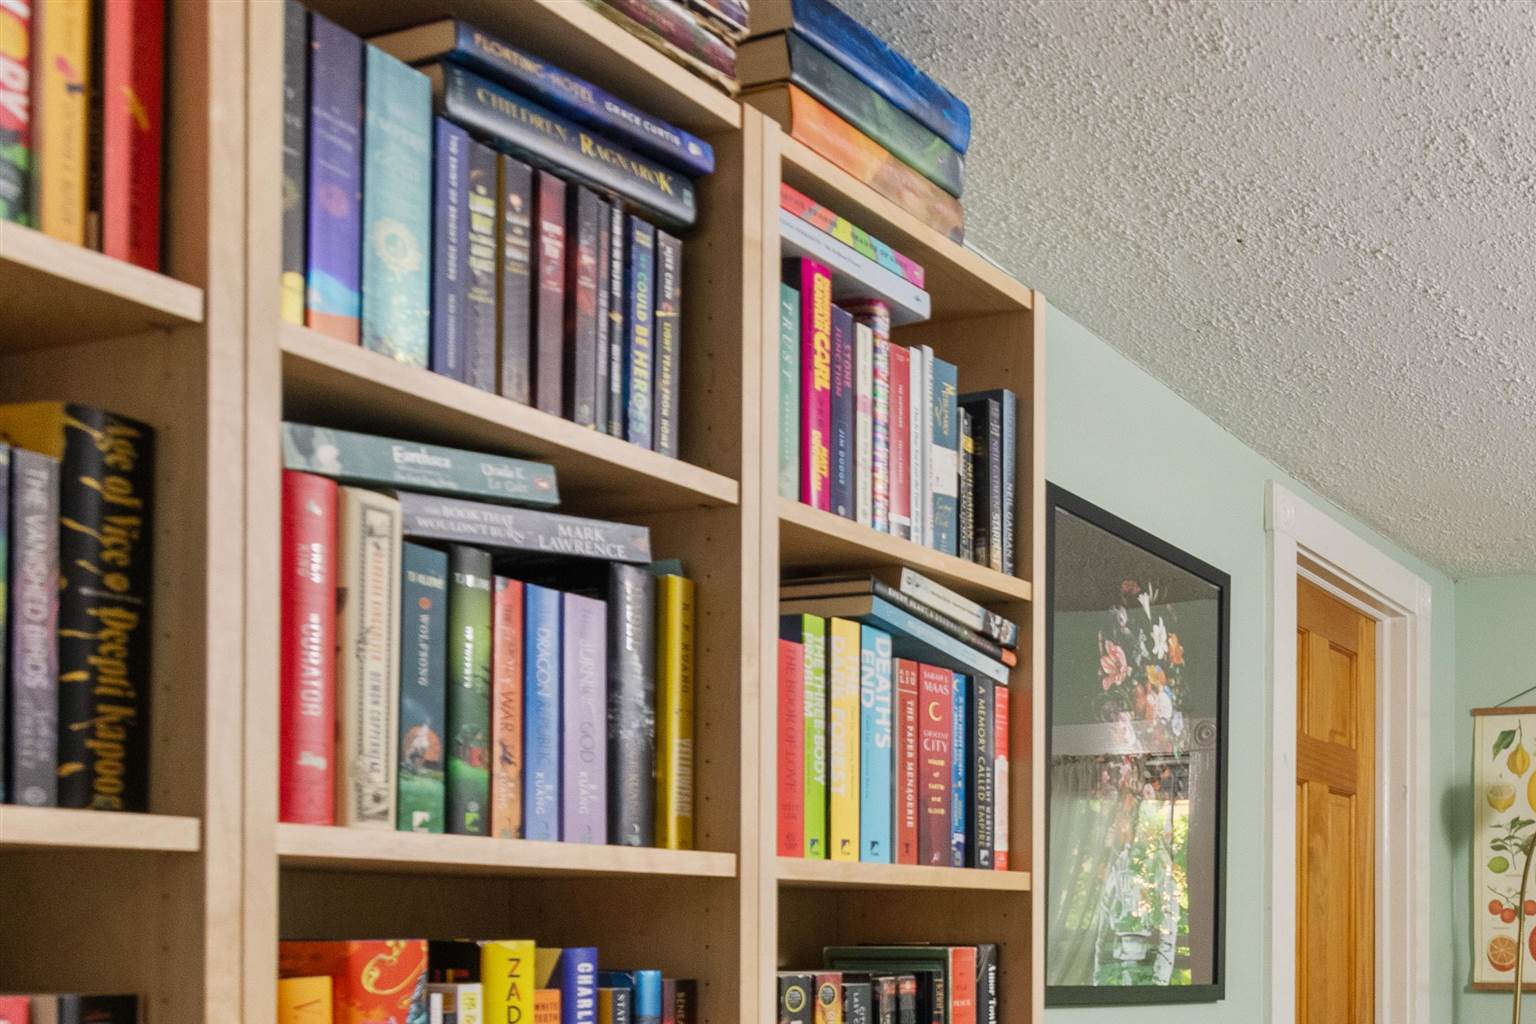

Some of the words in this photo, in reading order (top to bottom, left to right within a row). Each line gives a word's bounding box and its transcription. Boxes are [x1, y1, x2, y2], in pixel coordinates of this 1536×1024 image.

[634, 272, 650, 323] COULD
[633, 324, 650, 347] BE
[632, 349, 650, 435] HEROES
[1006, 482, 1014, 506] NEIL
[537, 534, 627, 560] LAWRENCE
[556, 524, 605, 542] MARK
[1006, 511, 1014, 557] GAIMAN
[534, 625, 552, 697] DRAGON
[803, 633, 814, 718] PROBLEM
[861, 648, 875, 708] END
[874, 636, 891, 749] DEATH'S
[923, 681, 950, 696] MAAS
[500, 690, 514, 732] WAR
[906, 699, 915, 722] THE
[977, 698, 986, 752] MEMORY
[579, 721, 596, 763] GOD
[906, 725, 915, 758] PAPER
[923, 738, 947, 752] CITY
[534, 771, 546, 815] KUANG
[906, 761, 915, 827] MENAGERIE
[977, 756, 986, 800] CALLED
[977, 804, 986, 847] EMPIRE
[987, 964, 996, 995] Amor
[852, 992, 860, 1014] LAST
